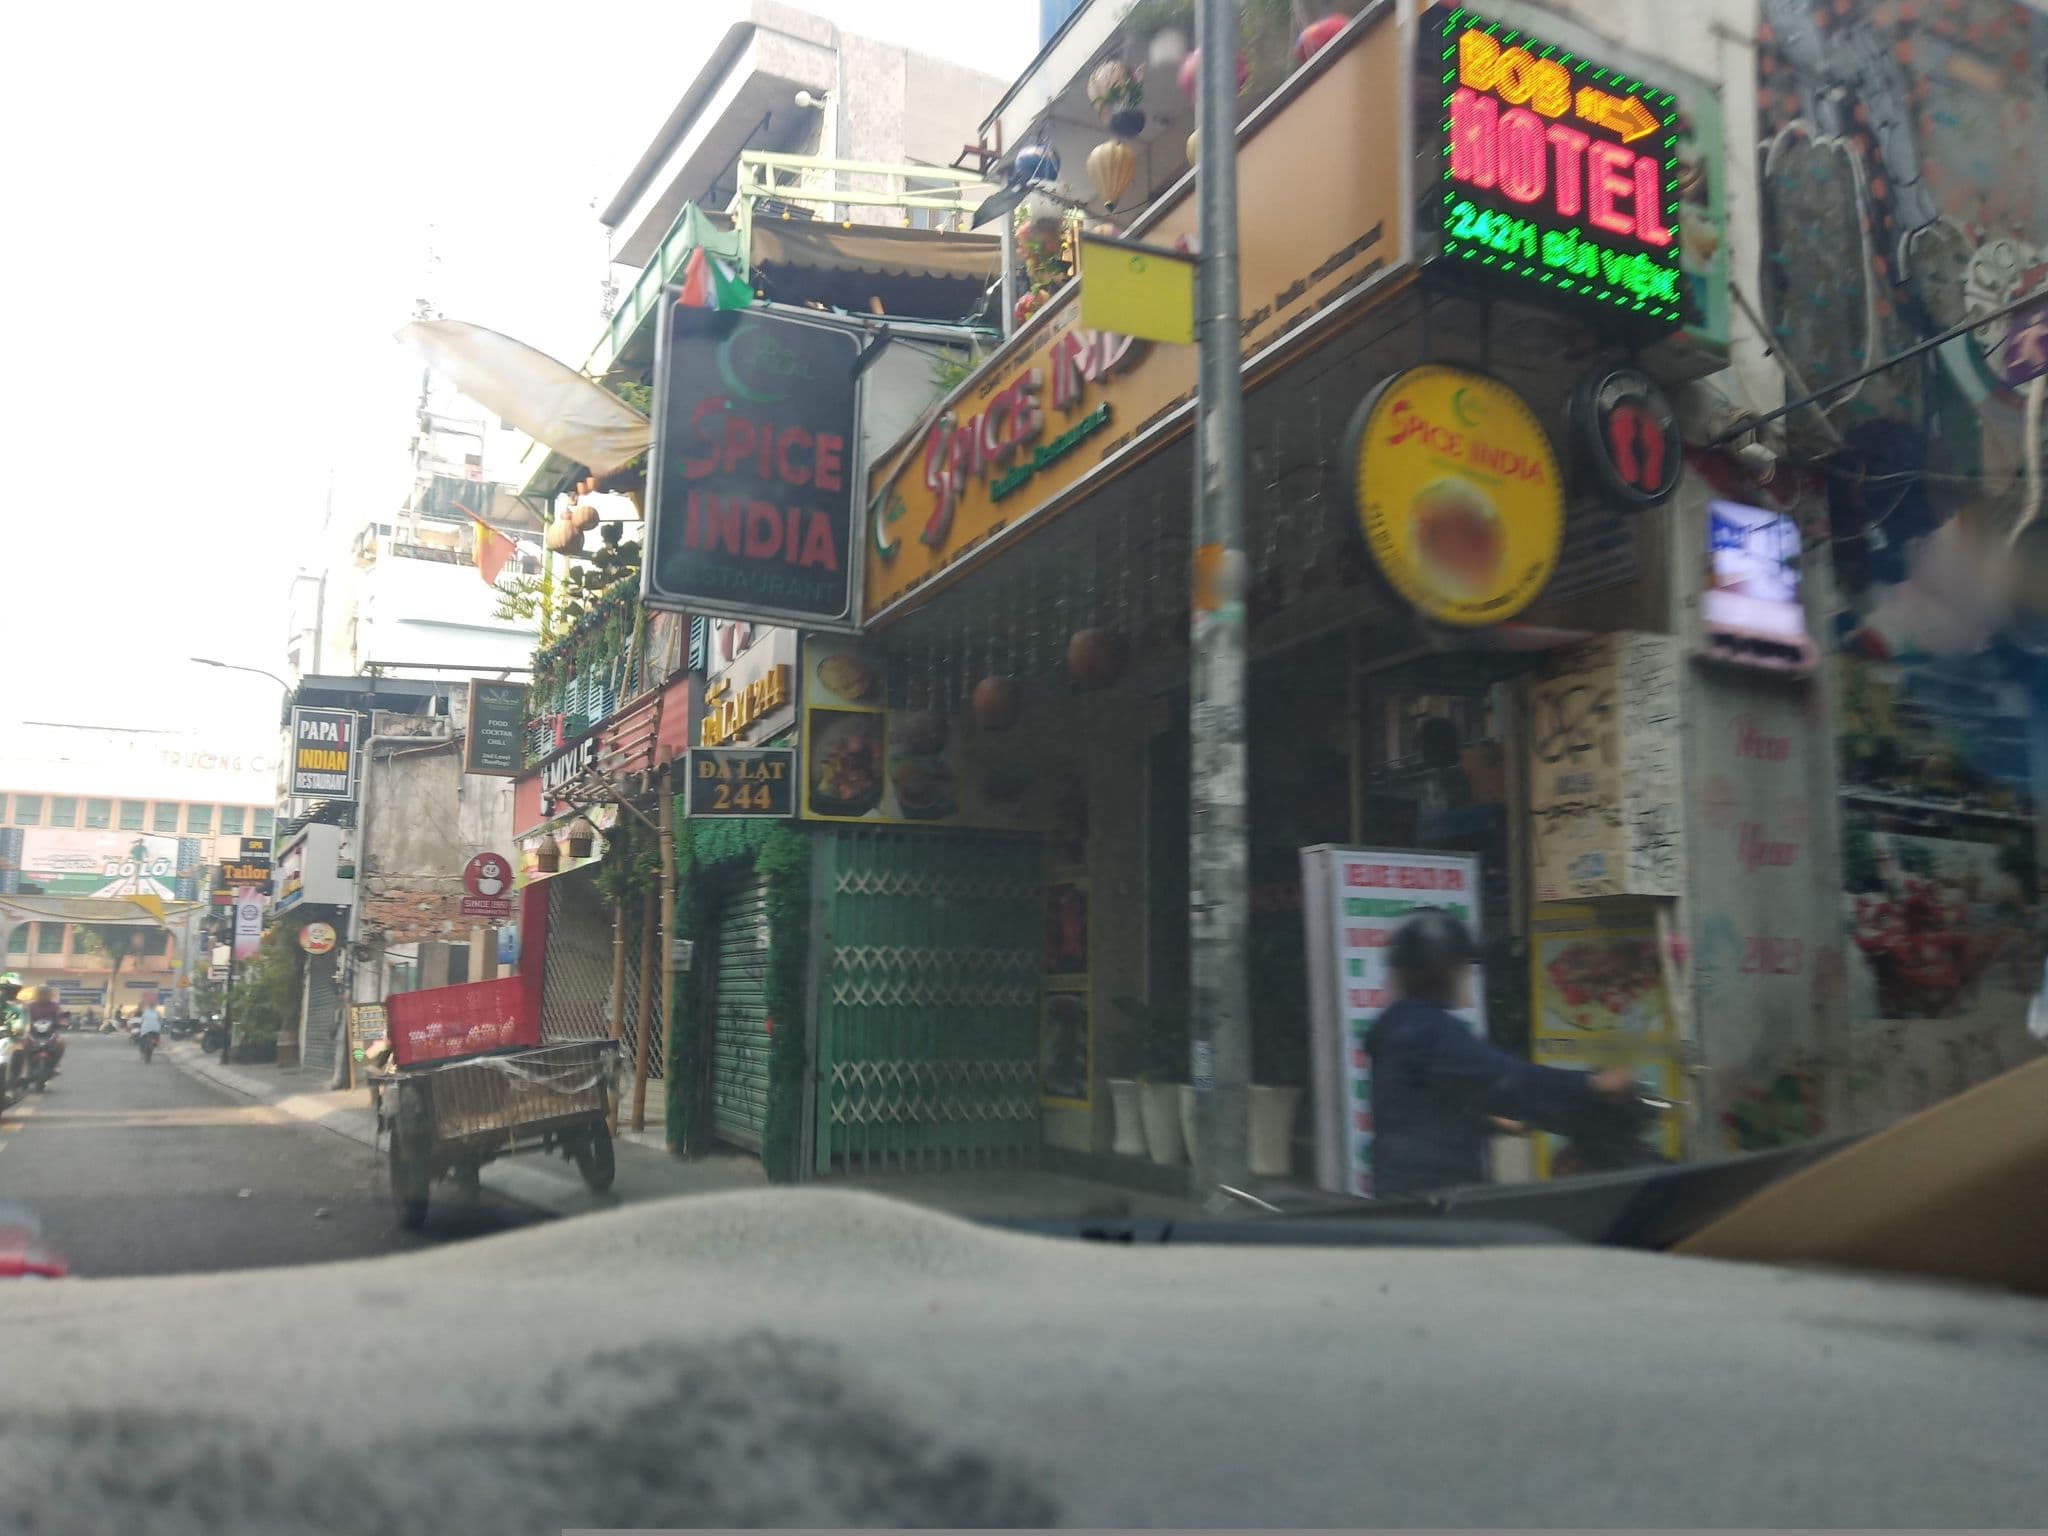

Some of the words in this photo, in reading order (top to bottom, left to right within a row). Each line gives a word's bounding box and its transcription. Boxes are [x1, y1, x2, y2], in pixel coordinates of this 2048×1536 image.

[1459, 28, 1571, 119] BOB
[1450, 87, 1672, 247] HOTEL
[680, 395, 844, 492] SPICE
[922, 366, 1043, 552] SPICE
[1387, 399, 1462, 458] SPICE
[1467, 440, 1546, 486] INDIA
[684, 489, 838, 571] INDIA
[487, 738, 507, 746] CHILL
[488, 719, 509, 727] FOOD
[295, 771, 347, 792] RESTAURANT
[298, 747, 347, 772] INDIAN
[712, 783, 771, 809] 244
[223, 864, 270, 880] Tailor
